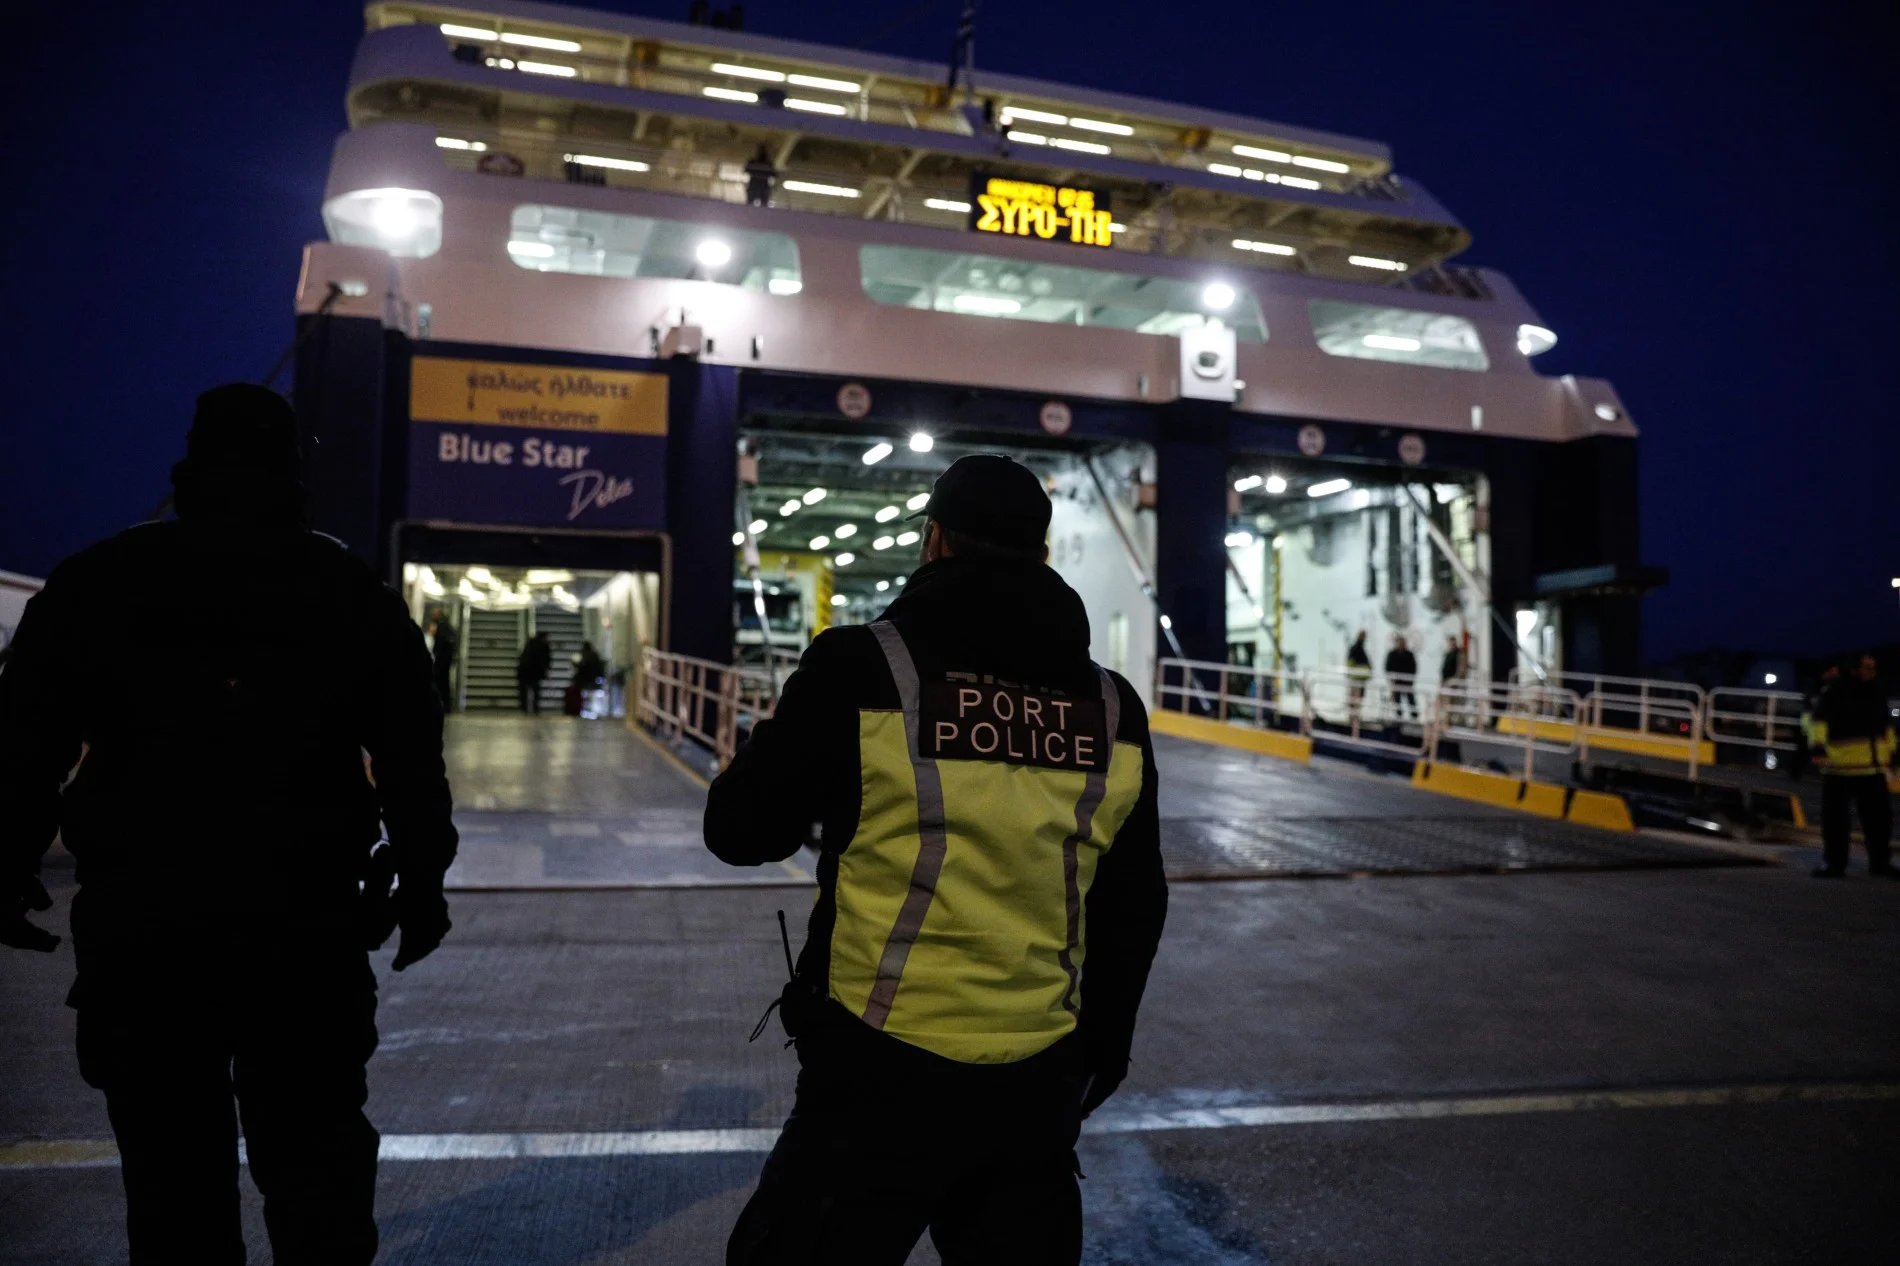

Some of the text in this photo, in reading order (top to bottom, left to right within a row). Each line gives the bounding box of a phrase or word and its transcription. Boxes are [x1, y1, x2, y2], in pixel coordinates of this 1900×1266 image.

[496, 404, 600, 426] welcome
[438, 432, 590, 469] Blue Star
[958, 687, 1073, 731] PORT
[935, 721, 1096, 767] POLICE
